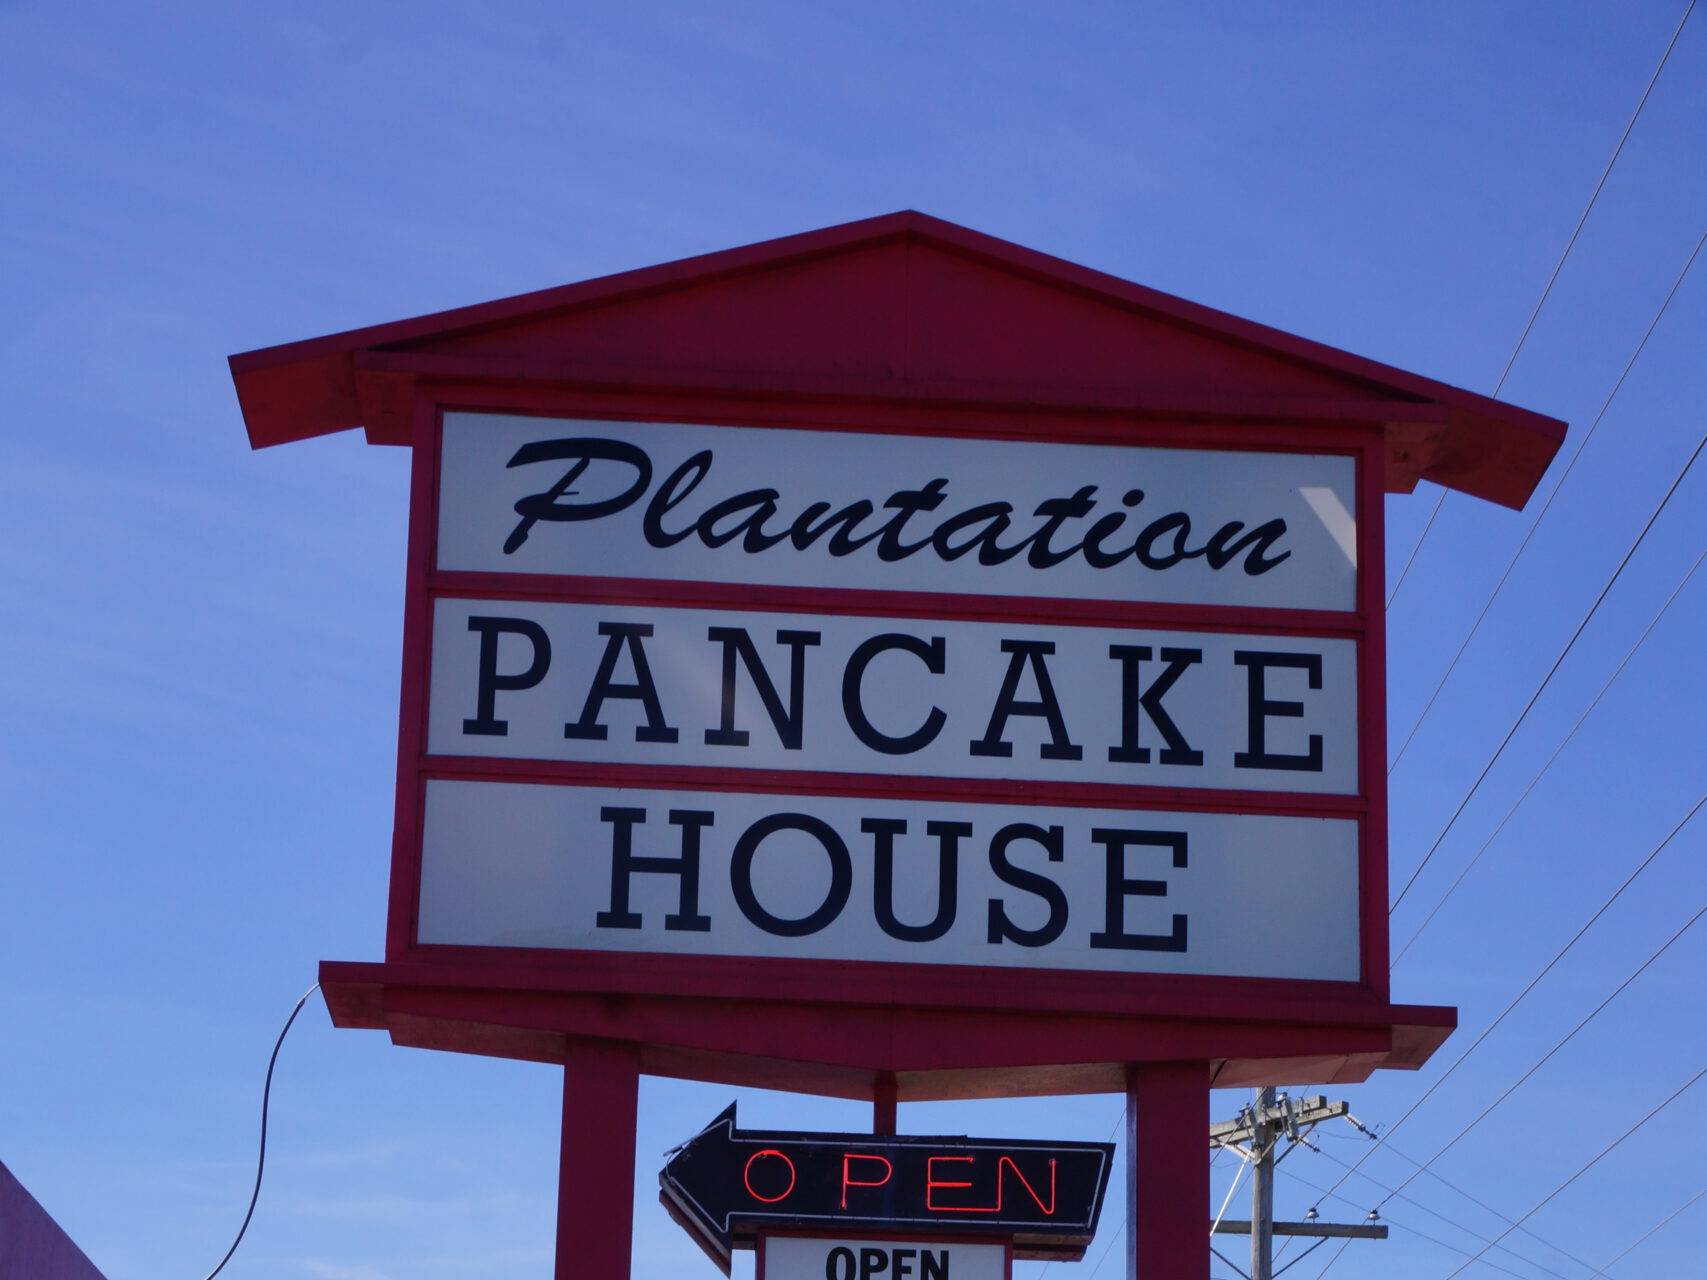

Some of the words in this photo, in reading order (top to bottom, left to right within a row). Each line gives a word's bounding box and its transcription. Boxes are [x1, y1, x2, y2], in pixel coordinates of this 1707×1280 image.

[503, 436, 1292, 576] Plantation
[462, 615, 1325, 773] PANCAKE
[596, 806, 1189, 954] HOUSE
[744, 1149, 1057, 1215] OPEN
